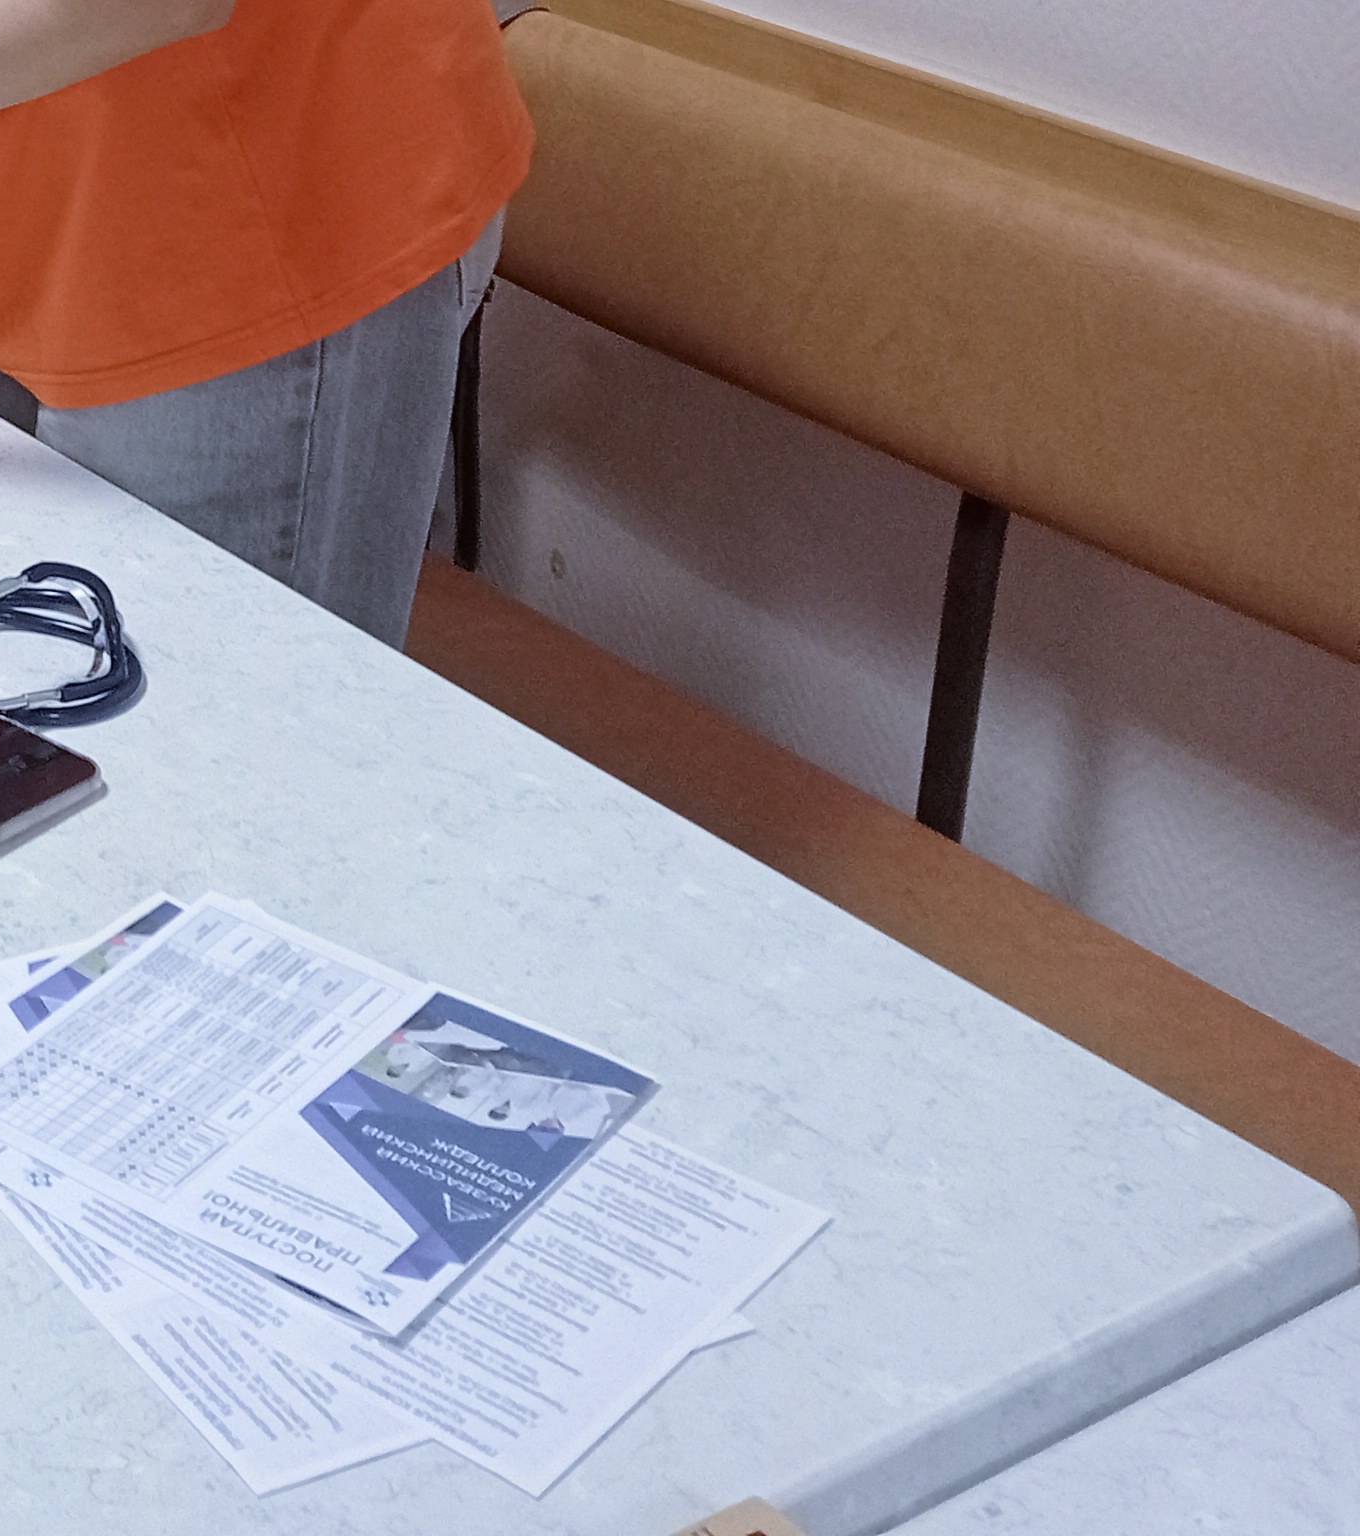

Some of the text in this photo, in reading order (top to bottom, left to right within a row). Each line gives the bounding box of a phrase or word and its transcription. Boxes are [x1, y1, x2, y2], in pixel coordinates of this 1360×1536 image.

[359, 1122, 524, 1201] МЕДИЦИНСКИЙ
[375, 1145, 511, 1212] КУЗБАССКИЙ
[429, 1136, 536, 1190] КОЛЛЕДЖ
[196, 1206, 334, 1275] ПОСТУПАЙ
[201, 1187, 363, 1267] ПРАВИЛЬНО!
